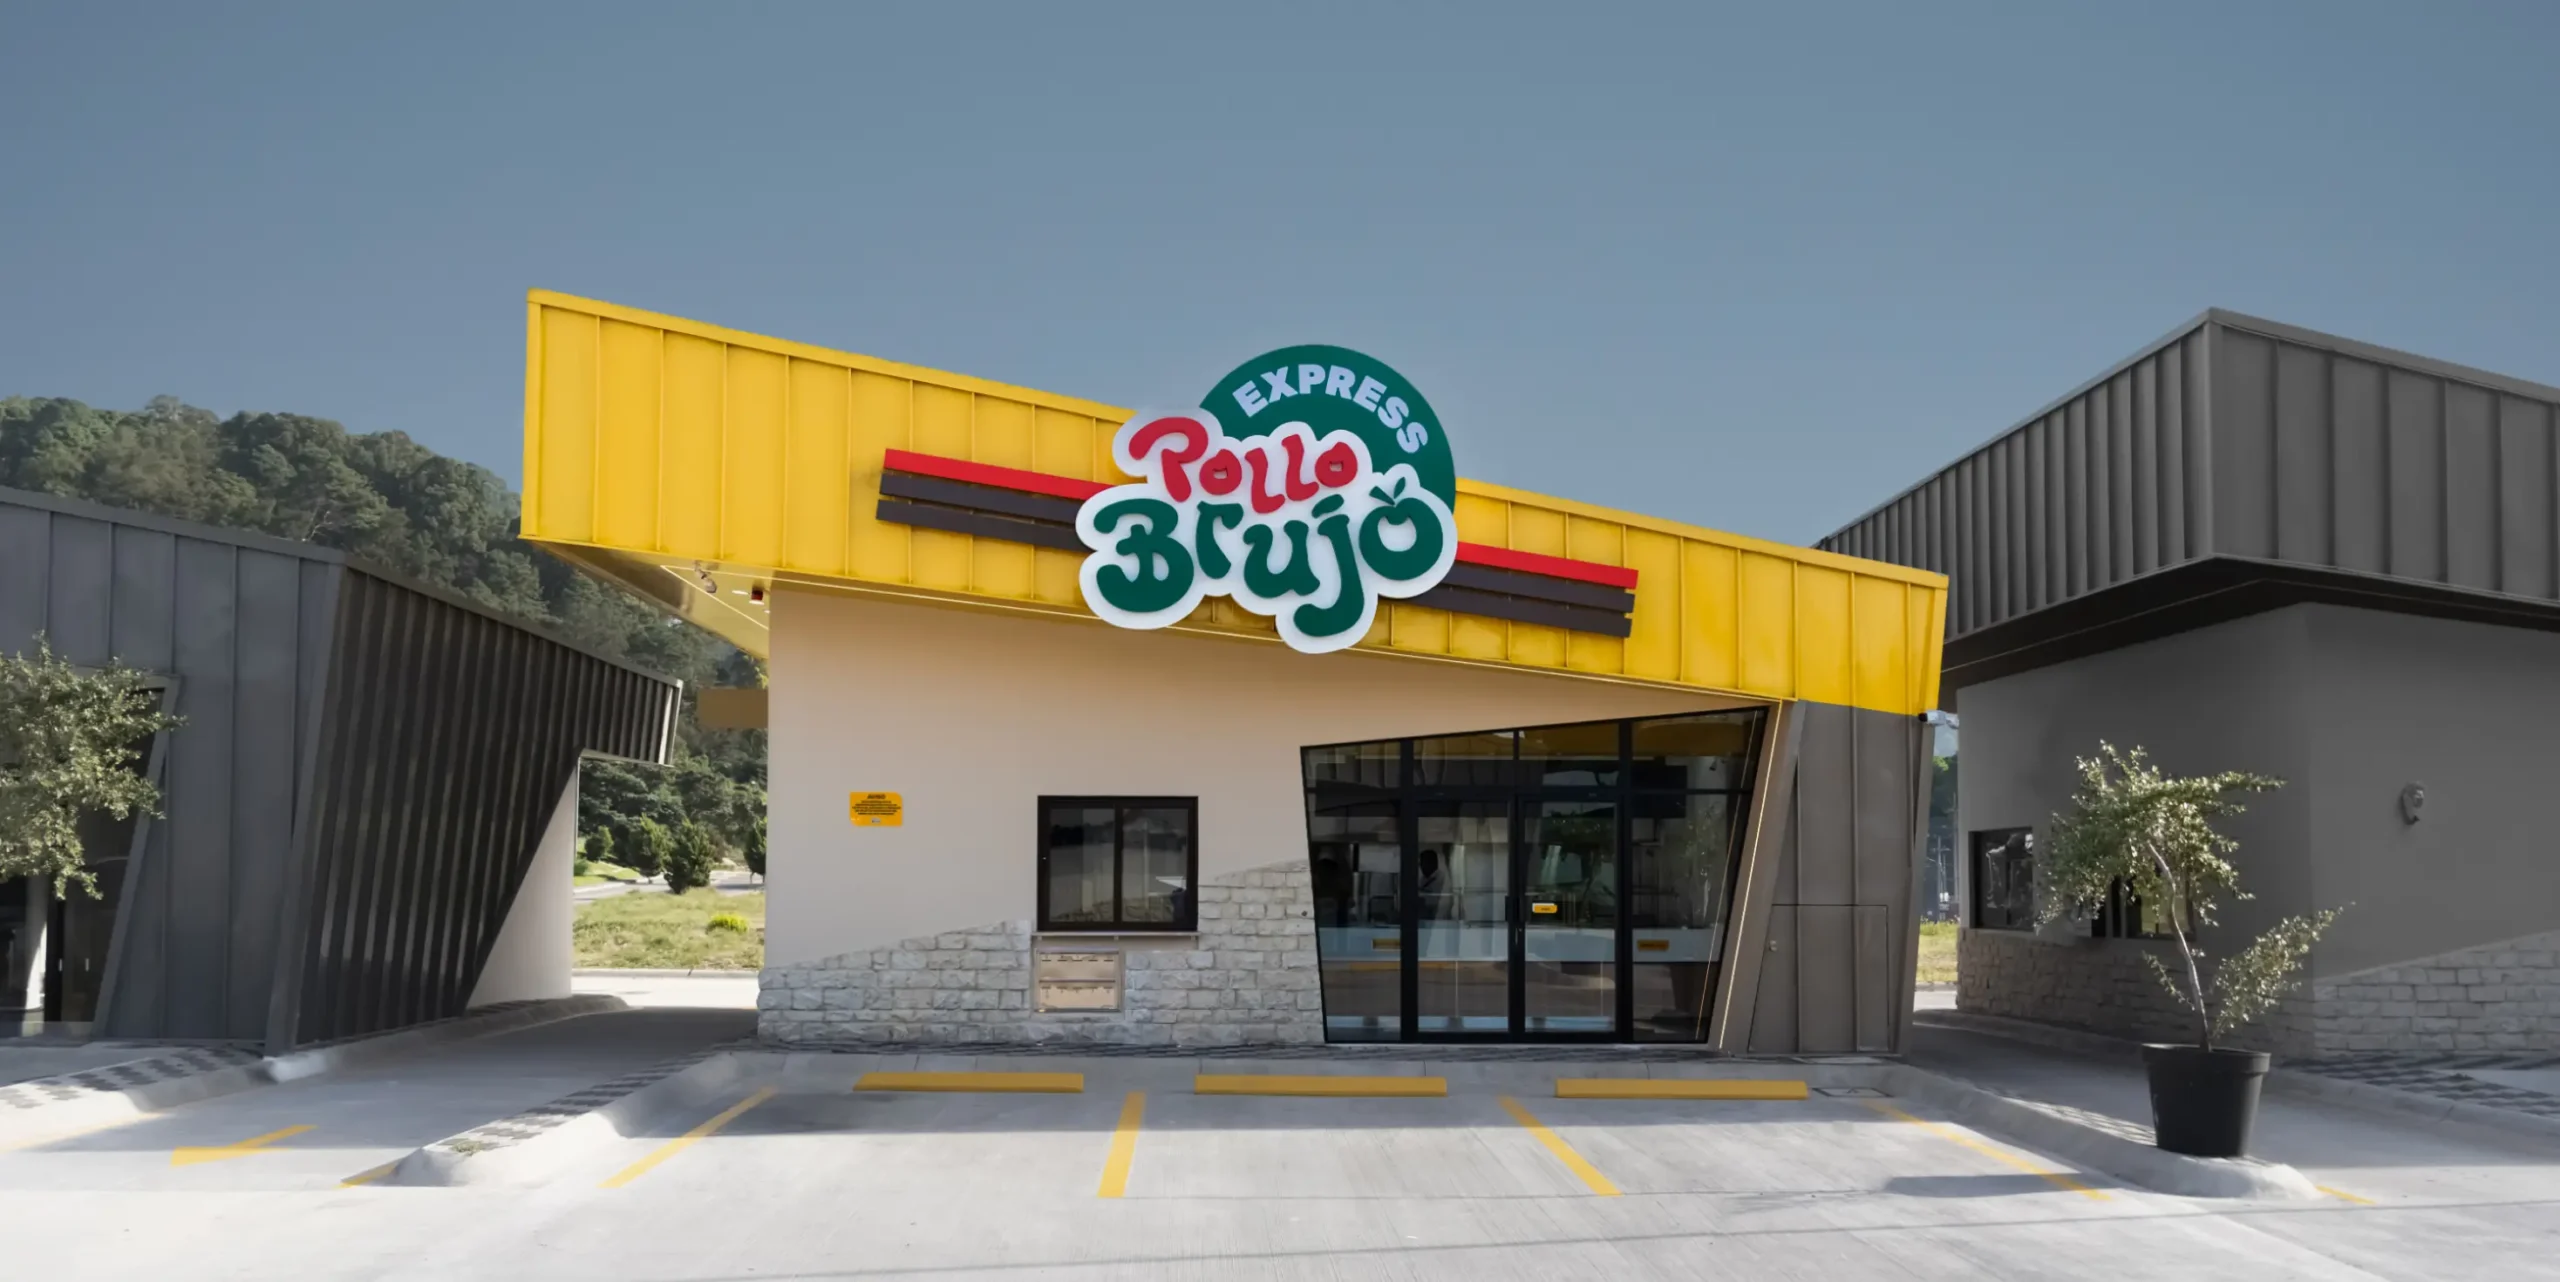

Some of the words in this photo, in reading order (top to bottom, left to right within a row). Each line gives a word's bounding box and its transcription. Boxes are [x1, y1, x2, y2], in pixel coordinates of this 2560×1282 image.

[1232, 364, 1428, 453] EXPRESS
[1129, 416, 1358, 514] Pollo
[1093, 477, 1444, 638] Brujo
